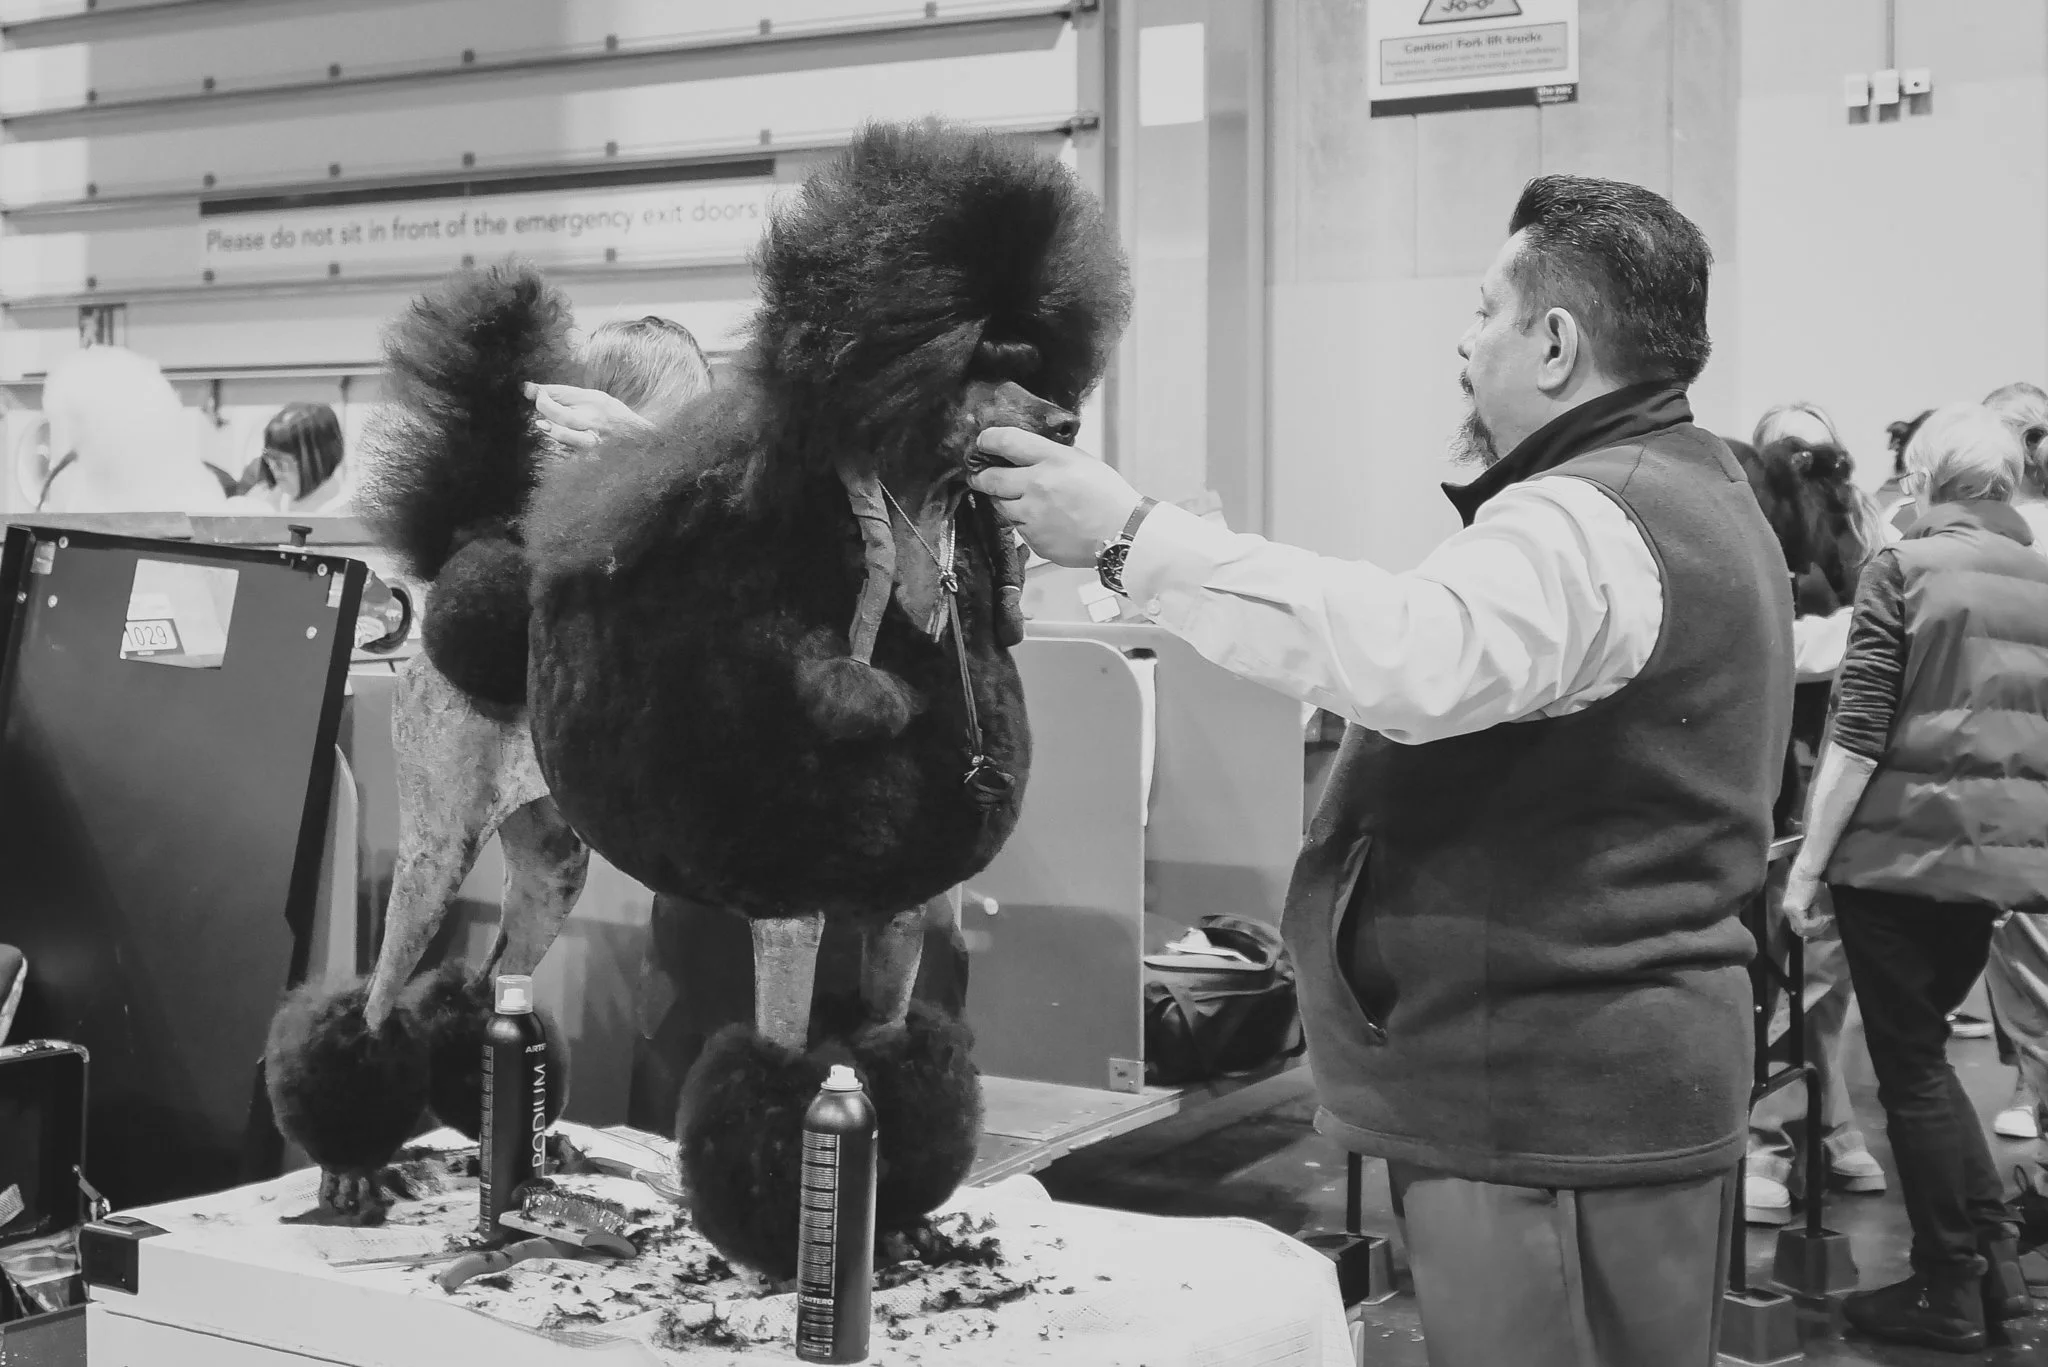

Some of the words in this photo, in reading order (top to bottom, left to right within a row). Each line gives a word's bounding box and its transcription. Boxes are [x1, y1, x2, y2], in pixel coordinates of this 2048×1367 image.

[206, 228, 265, 251] Please
[270, 224, 296, 249] do
[301, 226, 334, 247] not
[340, 223, 363, 245] sit
[368, 218, 386, 242] in
[392, 215, 441, 241] front
[445, 210, 466, 238] of
[473, 209, 507, 235] the
[513, 209, 635, 238] emergency
[642, 204, 684, 226] exit
[691, 197, 759, 223] doors
[531, 1063, 547, 1168] PODIUM
